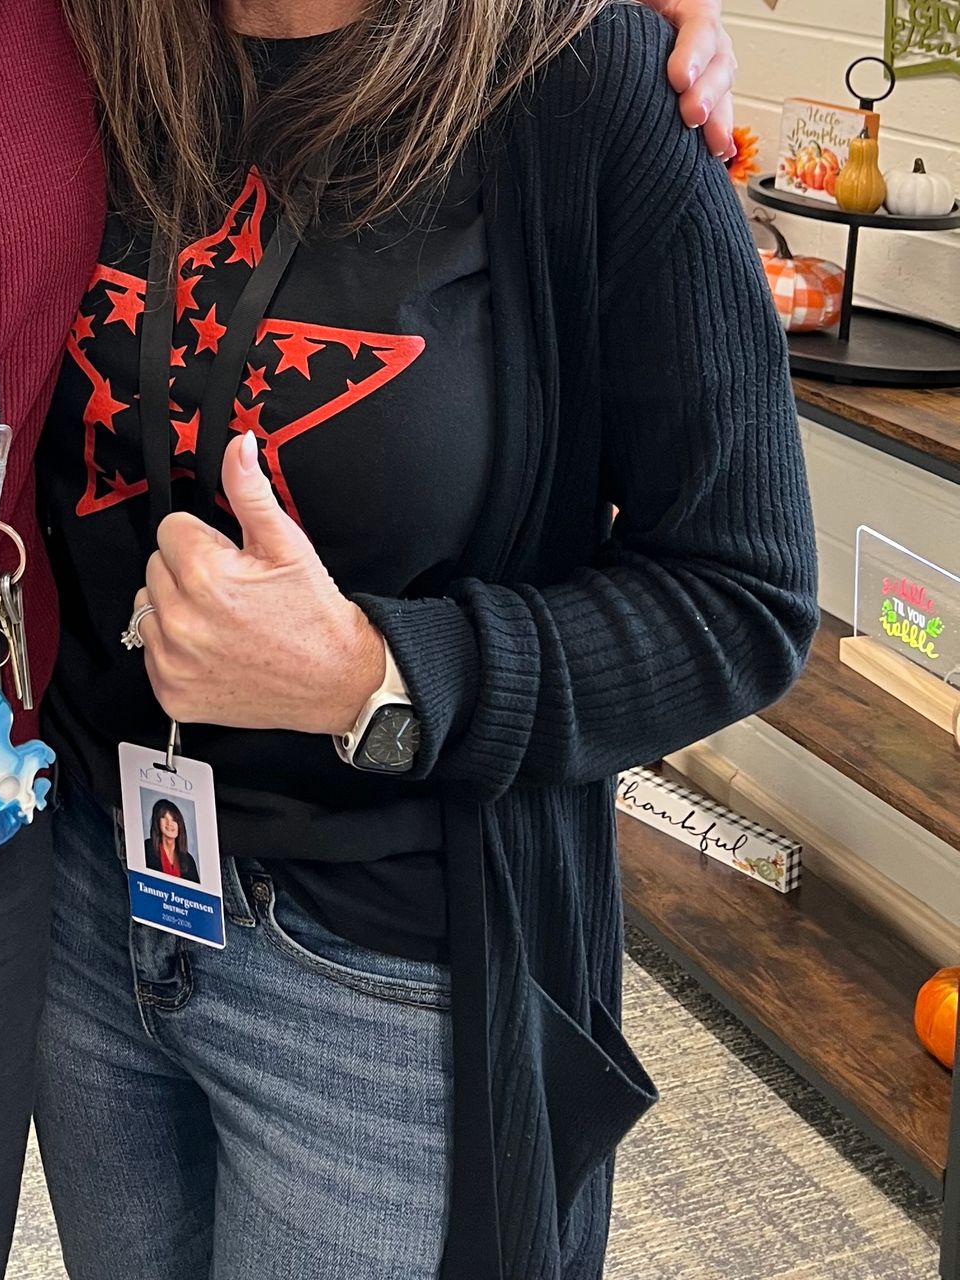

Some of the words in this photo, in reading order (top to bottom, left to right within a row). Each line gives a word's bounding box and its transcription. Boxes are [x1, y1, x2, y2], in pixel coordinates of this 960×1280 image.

[807, 106, 841, 125] Hello
[907, 606, 926, 628] YOU
[136, 880, 169, 901] Tammy
[170, 891, 214, 914] Jorgensen
[162, 903, 189, 917] DISTRICT
